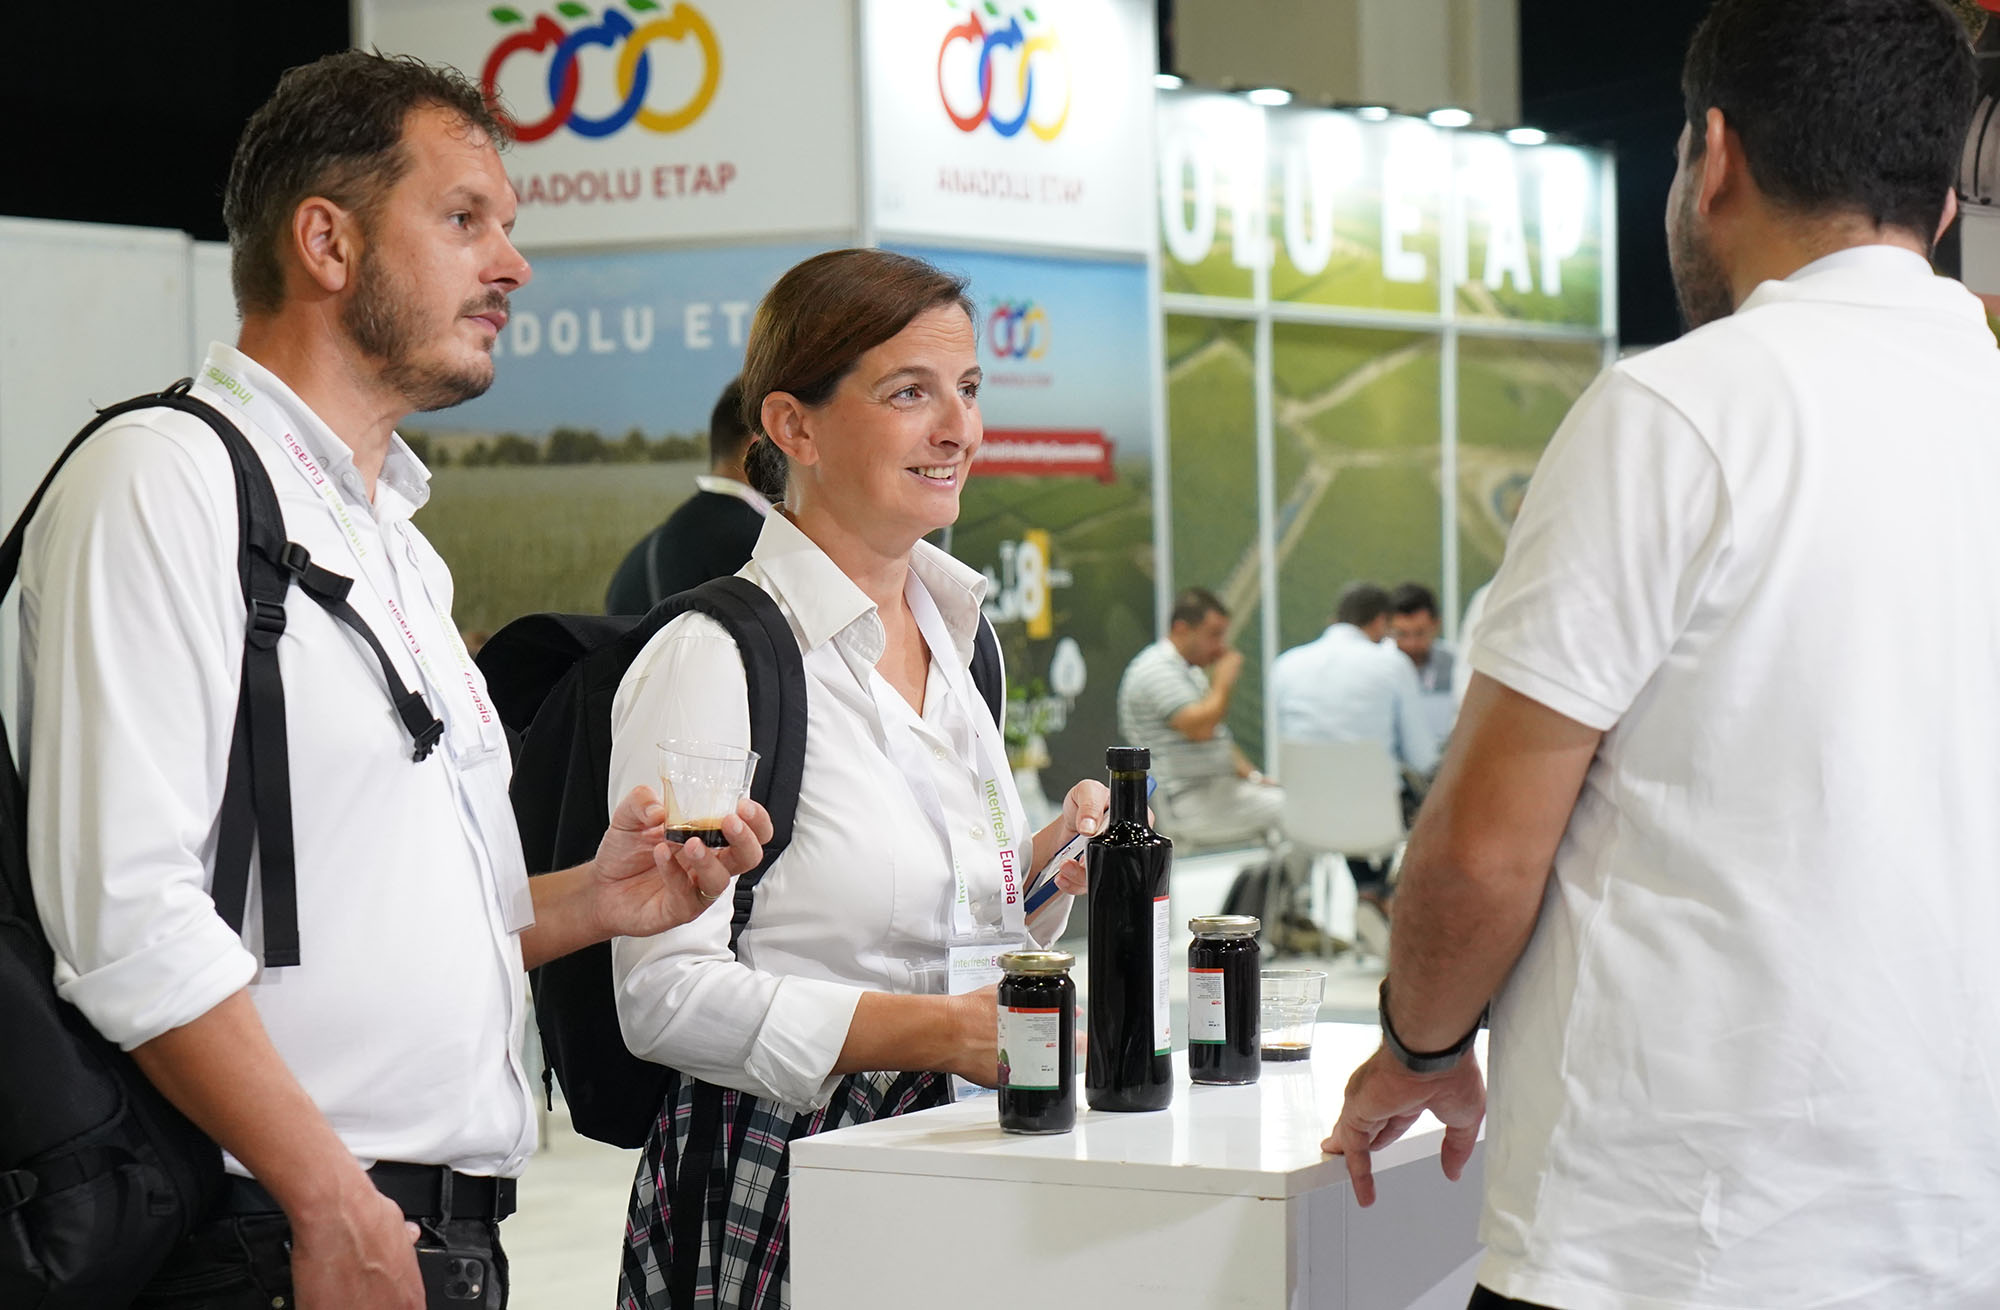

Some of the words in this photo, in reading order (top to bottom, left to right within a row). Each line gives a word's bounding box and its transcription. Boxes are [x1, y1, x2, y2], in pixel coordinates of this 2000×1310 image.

[511, 168, 642, 206] NADOLU
[653, 162, 737, 199] ETAP
[284, 433, 325, 485] Eurasia
[464, 672, 493, 723] Eurasia
[984, 778, 1011, 848] Interfresh
[1000, 849, 1019, 905] Eurasia
